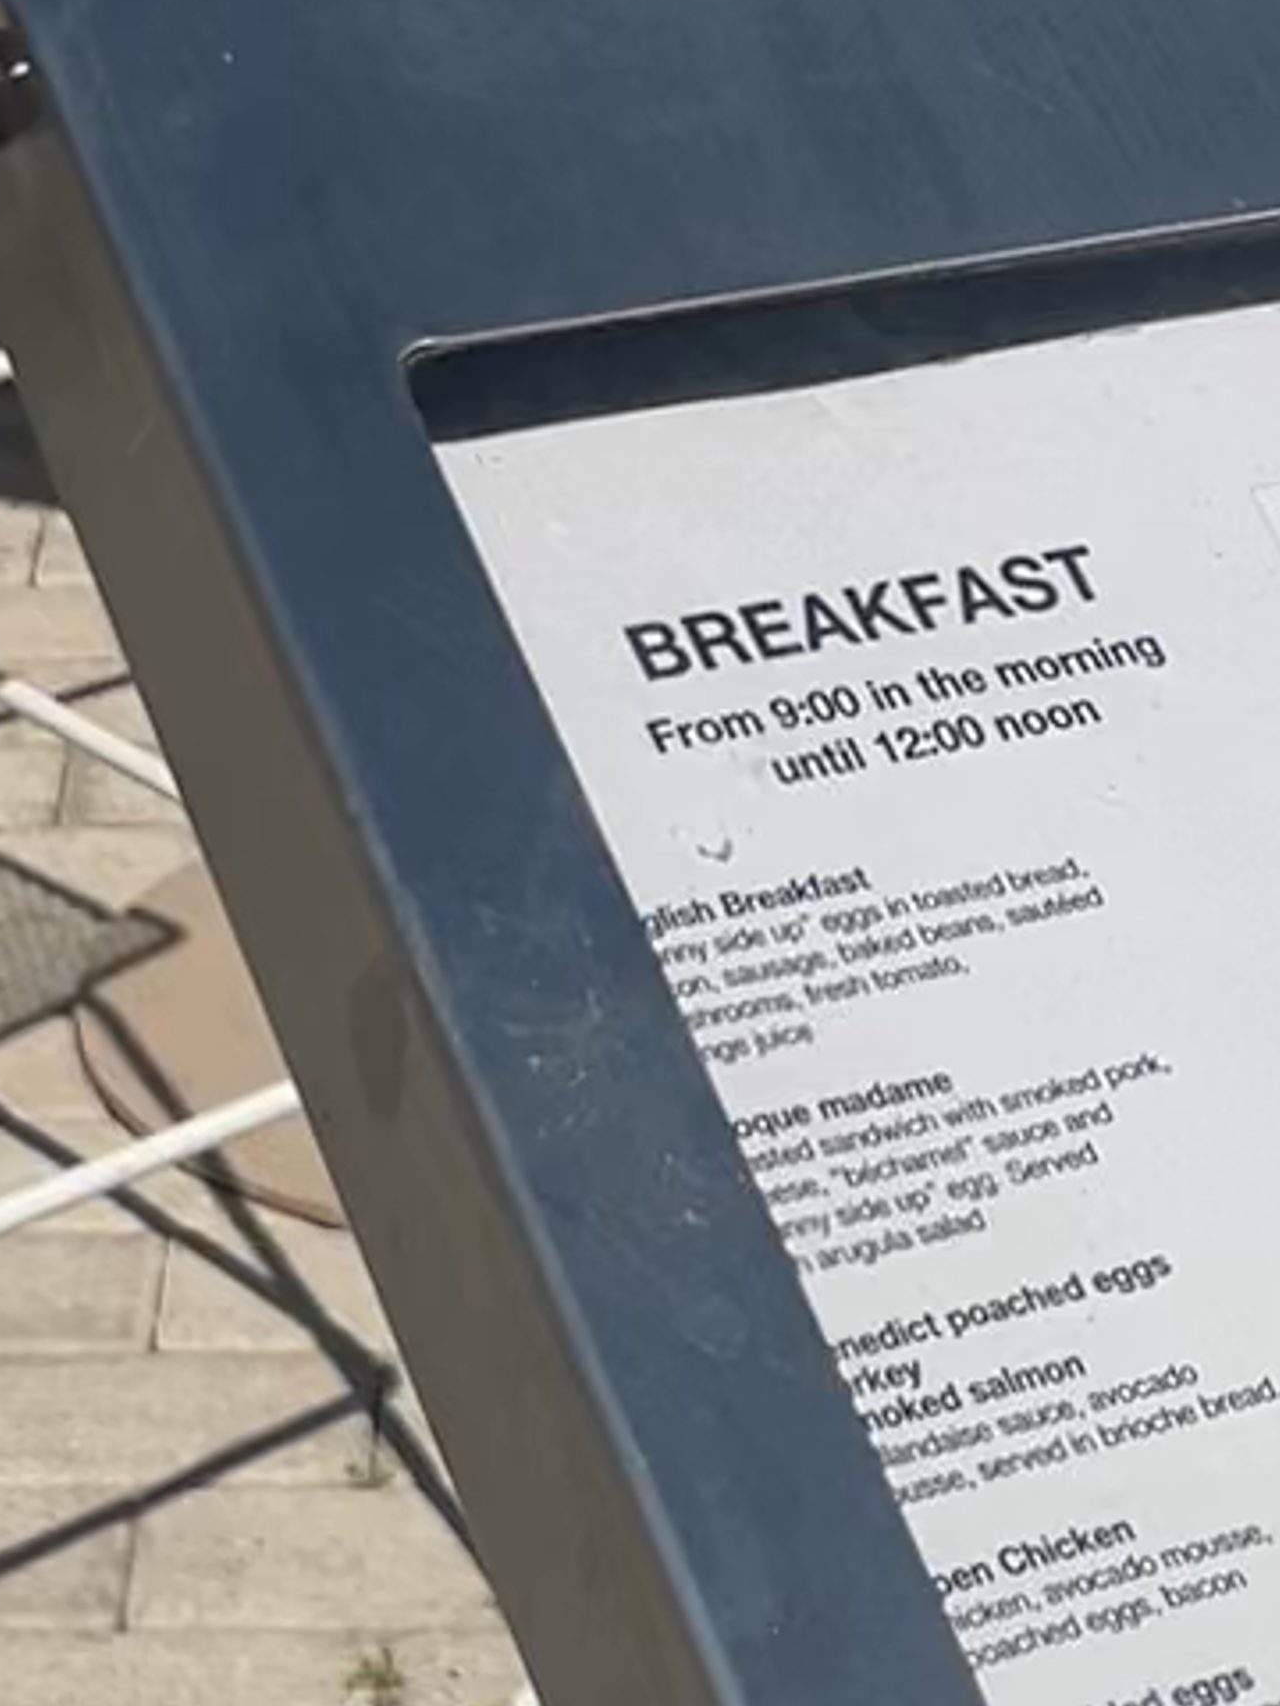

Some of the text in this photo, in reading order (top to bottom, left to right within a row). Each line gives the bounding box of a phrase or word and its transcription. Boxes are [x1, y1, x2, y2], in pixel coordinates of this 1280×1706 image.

[623, 544, 1095, 681] BREAKFAST
[645, 635, 1166, 754] From 9:00 in the morning
[770, 698, 1102, 785] until 12:00 noon
[718, 866, 871, 918] Breakfast
[816, 1072, 953, 1120] madame
[944, 1255, 1172, 1338] poached eggs
[966, 1355, 1086, 1404] salmon
[996, 1520, 1136, 1576] Chicken
